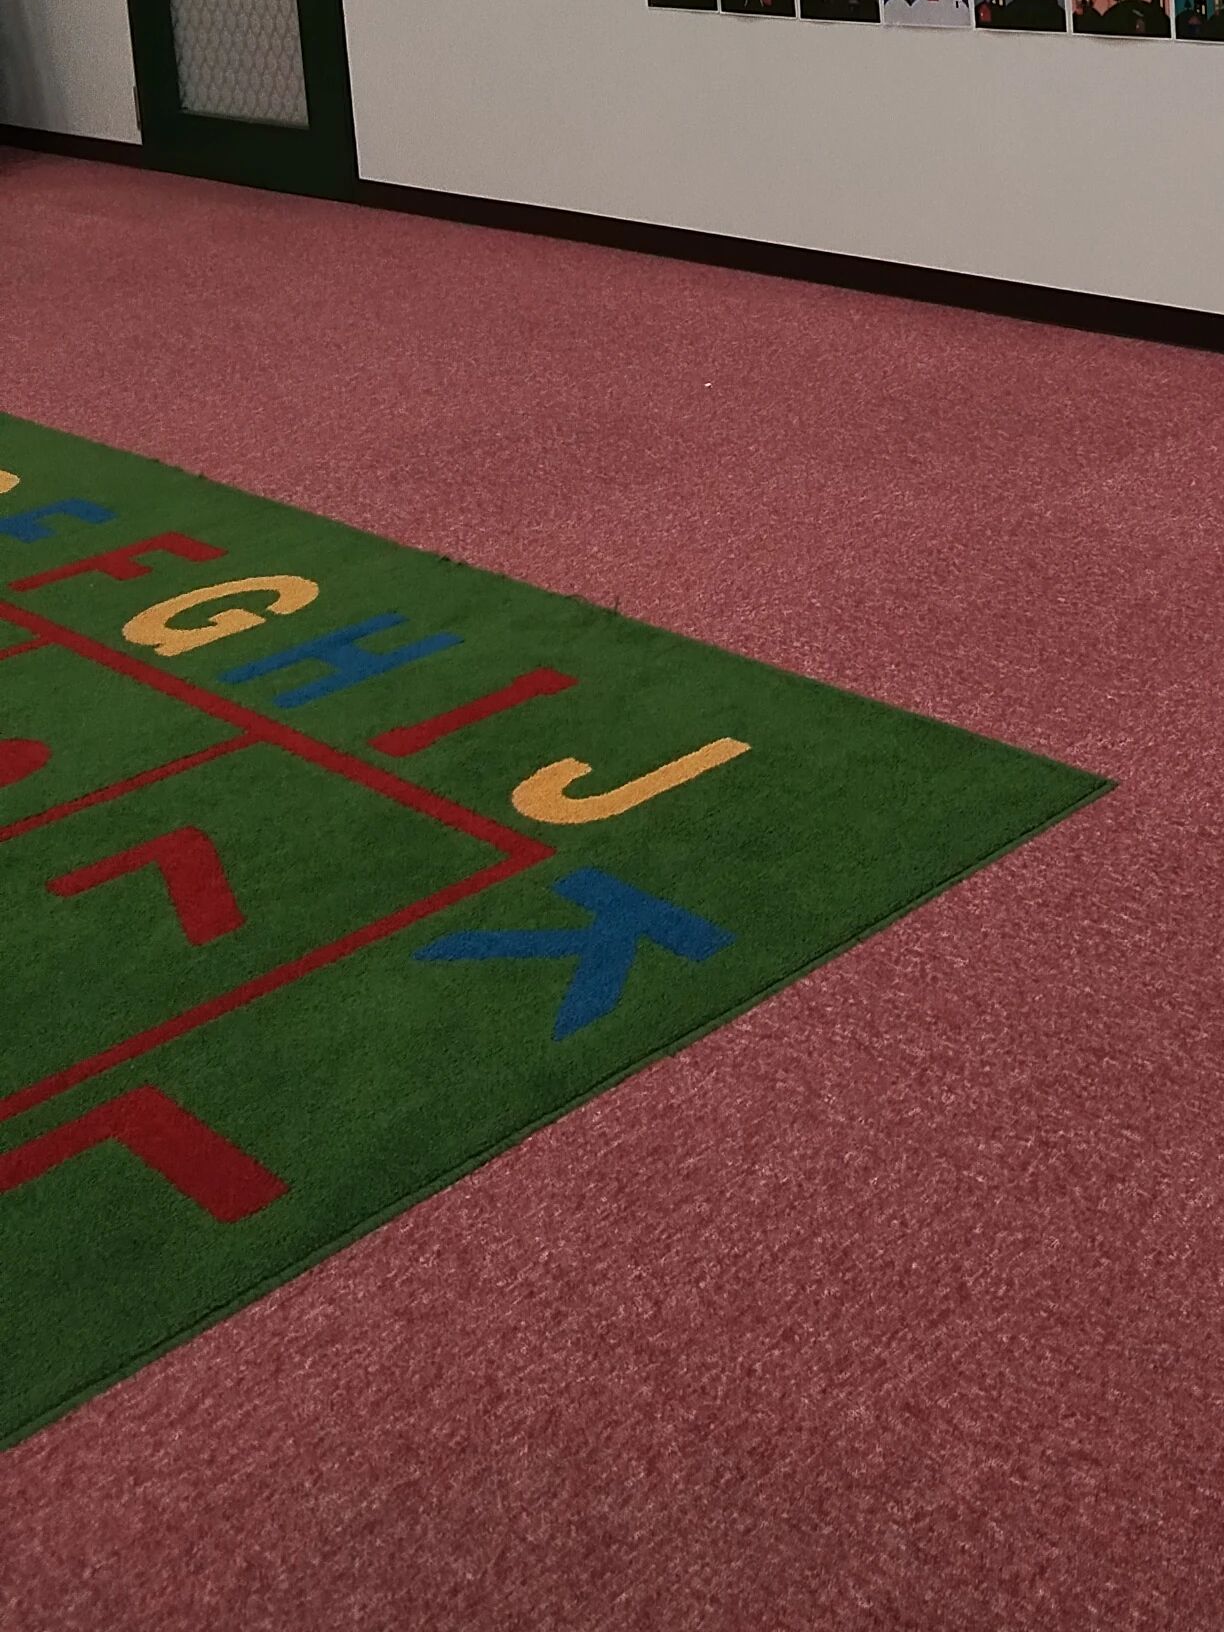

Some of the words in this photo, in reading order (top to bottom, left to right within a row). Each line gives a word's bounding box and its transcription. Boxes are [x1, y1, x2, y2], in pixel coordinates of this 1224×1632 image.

[8, 531, 228, 592] F
[121, 575, 320, 658] G
[216, 611, 466, 710] H
[511, 736, 754, 826] J
[413, 867, 738, 1043] K
